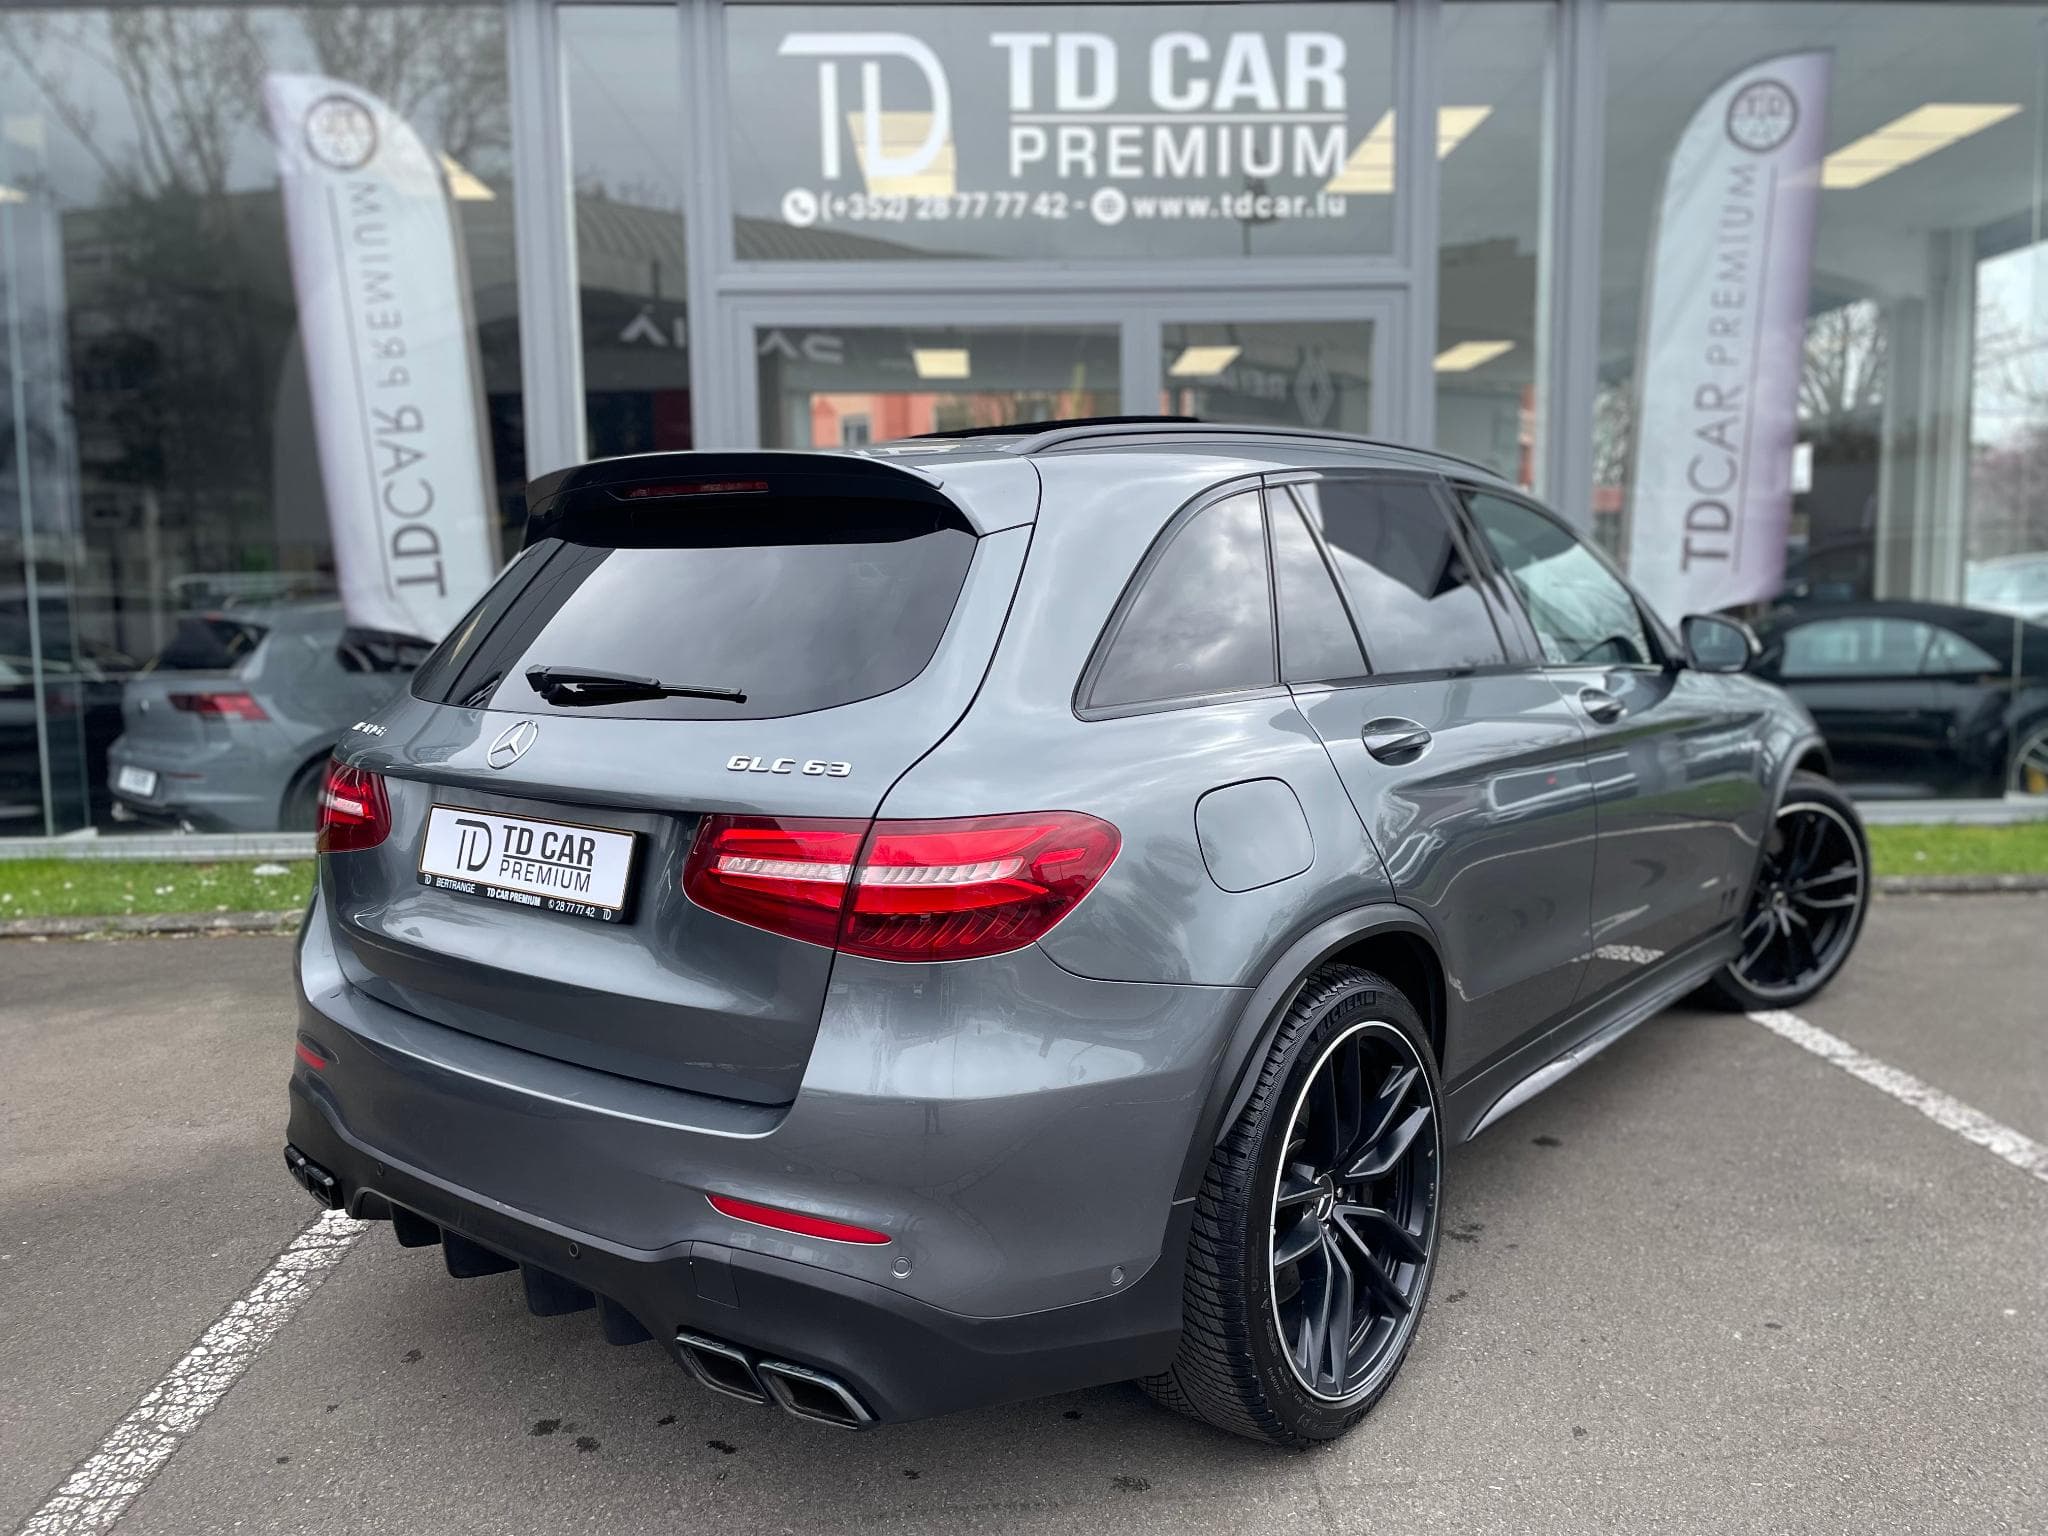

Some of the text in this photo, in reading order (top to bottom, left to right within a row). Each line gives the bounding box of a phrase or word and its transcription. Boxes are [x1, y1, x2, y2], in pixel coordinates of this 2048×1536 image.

[990, 31, 1347, 111] TD CAR
[1010, 125, 1348, 177] PREMIUM
[821, 191, 908, 223] (+352)
[956, 192, 988, 219] 77
[995, 192, 1027, 219] 77
[1032, 191, 1068, 220] 42
[1131, 191, 1347, 220] www.tdcar.lu
[1680, 163, 1757, 573] TDCAR PREMIUM
[726, 756, 852, 777] GLC 63
[502, 825, 596, 867] TD CAR
[499, 860, 591, 893] PREMIUM
[435, 878, 476, 894] BERTRANGE
[486, 887, 495, 897] TD
[495, 889, 509, 901] CAR
[509, 891, 541, 906] PREMIUM
[555, 900, 565, 911] 28
[565, 902, 575, 913] 77
[575, 904, 585, 915] 77
[585, 906, 596, 918] 42
